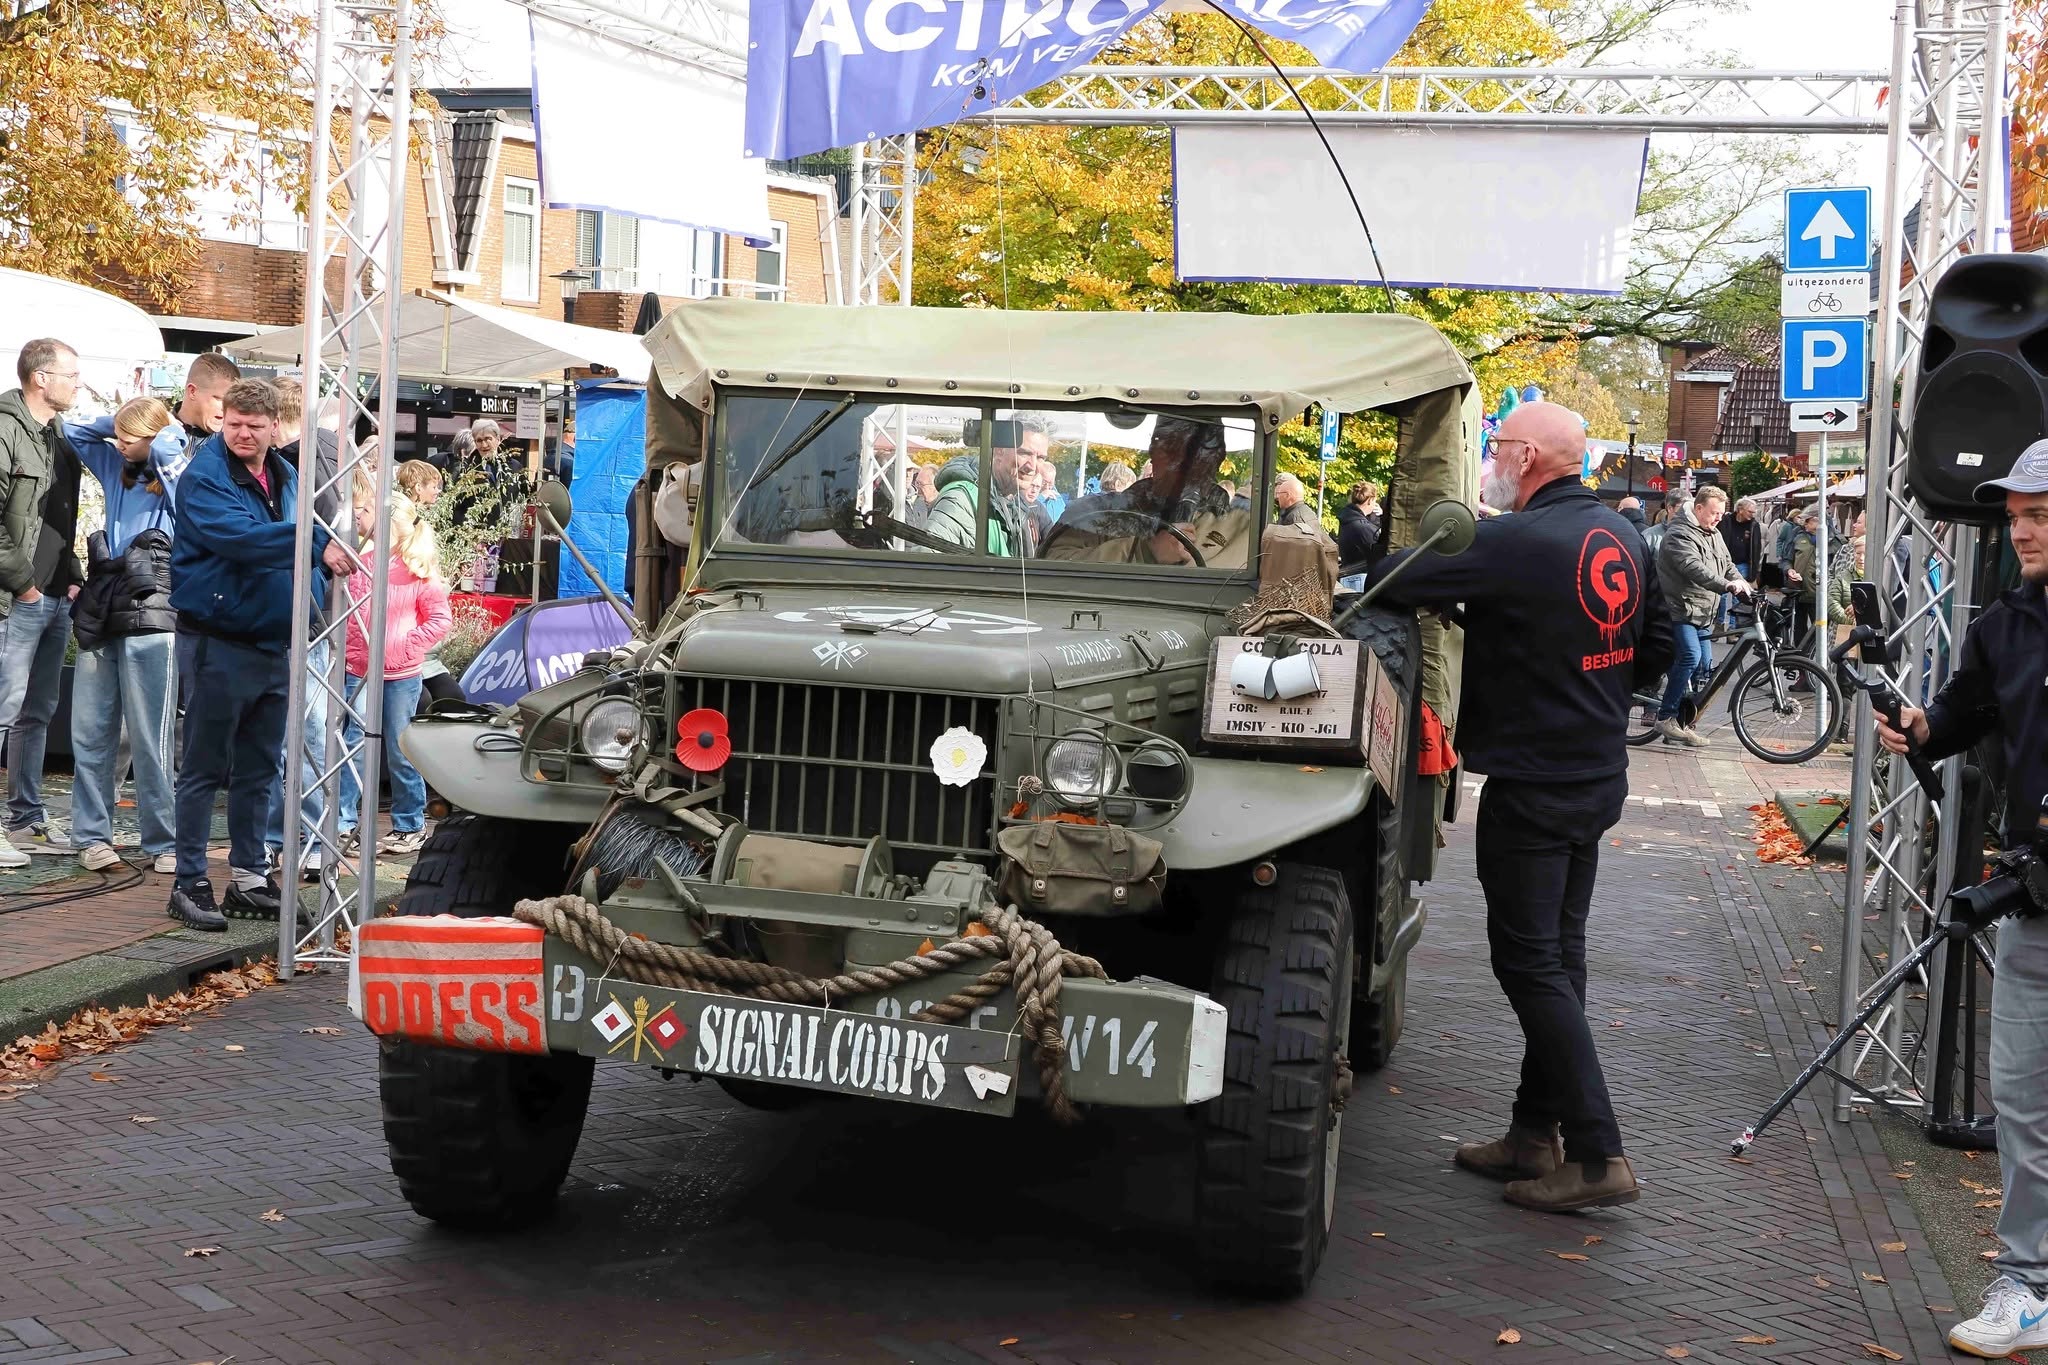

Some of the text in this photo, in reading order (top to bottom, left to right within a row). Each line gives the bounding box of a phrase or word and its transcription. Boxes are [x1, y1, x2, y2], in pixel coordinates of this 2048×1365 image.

[1787, 277, 1864, 288] uitgezonderd
[1802, 330, 1847, 390] P
[1327, 411, 1336, 436] P
[1590, 547, 1629, 610] G
[1583, 648, 1633, 671] BESTUUR
[1229, 703, 1258, 713] FOR:
[694, 1004, 824, 1083] SIGNAL
[829, 1018, 949, 1100] CORPS
